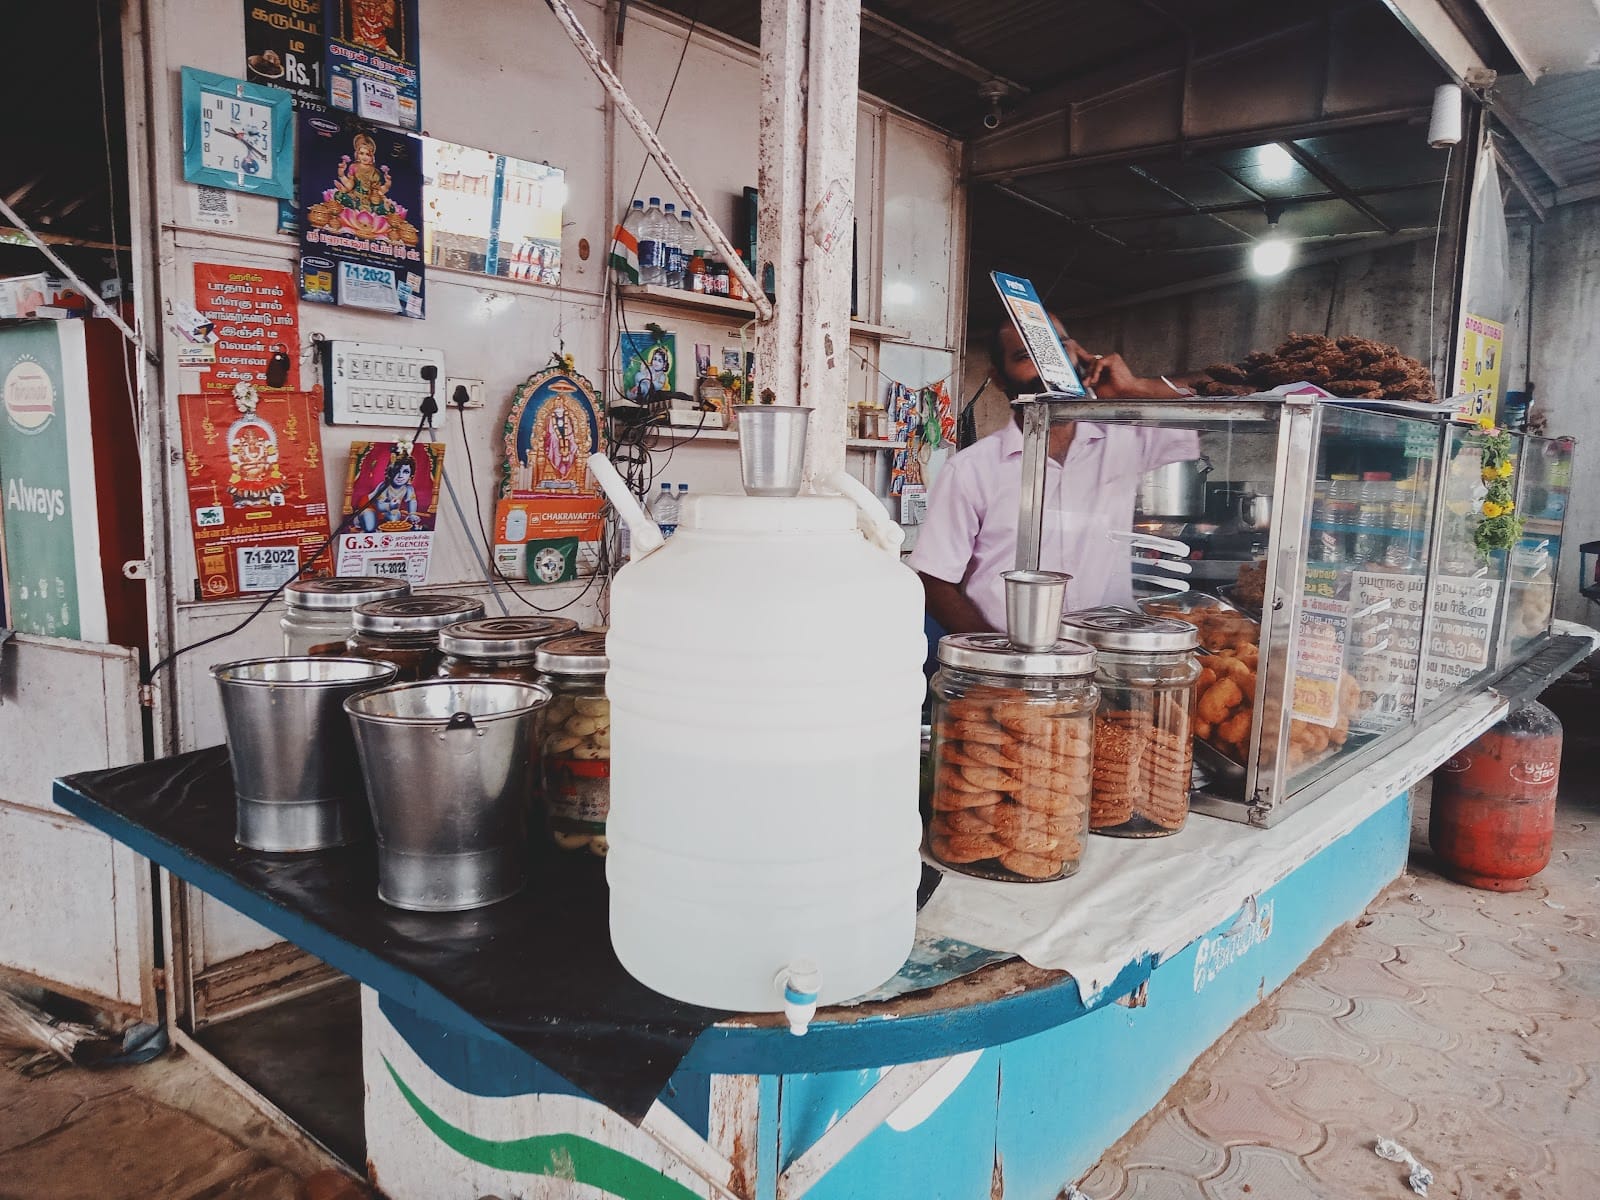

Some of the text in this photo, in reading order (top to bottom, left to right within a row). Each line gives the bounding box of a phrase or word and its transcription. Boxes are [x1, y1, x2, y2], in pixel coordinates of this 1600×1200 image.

[203, 108, 213, 119] 10
[232, 103, 240, 121] 12
[204, 121, 210, 138] 9
[262, 120, 268, 130] 2
[204, 142, 210, 152] 8
[262, 134, 268, 150] 3
[217, 155, 224, 166] 7
[234, 155, 240, 169] 6
[208, 282, 284, 296] பாதாம் பால்
[210, 295, 283, 310] மிளகு பால்
[273, 313, 293, 325] பால்
[221, 326, 265, 338] இஞ்சி
[219, 340, 265, 352] லெமன்
[8, 478, 65, 522] Always
[1533, 767, 1555, 782] gas
